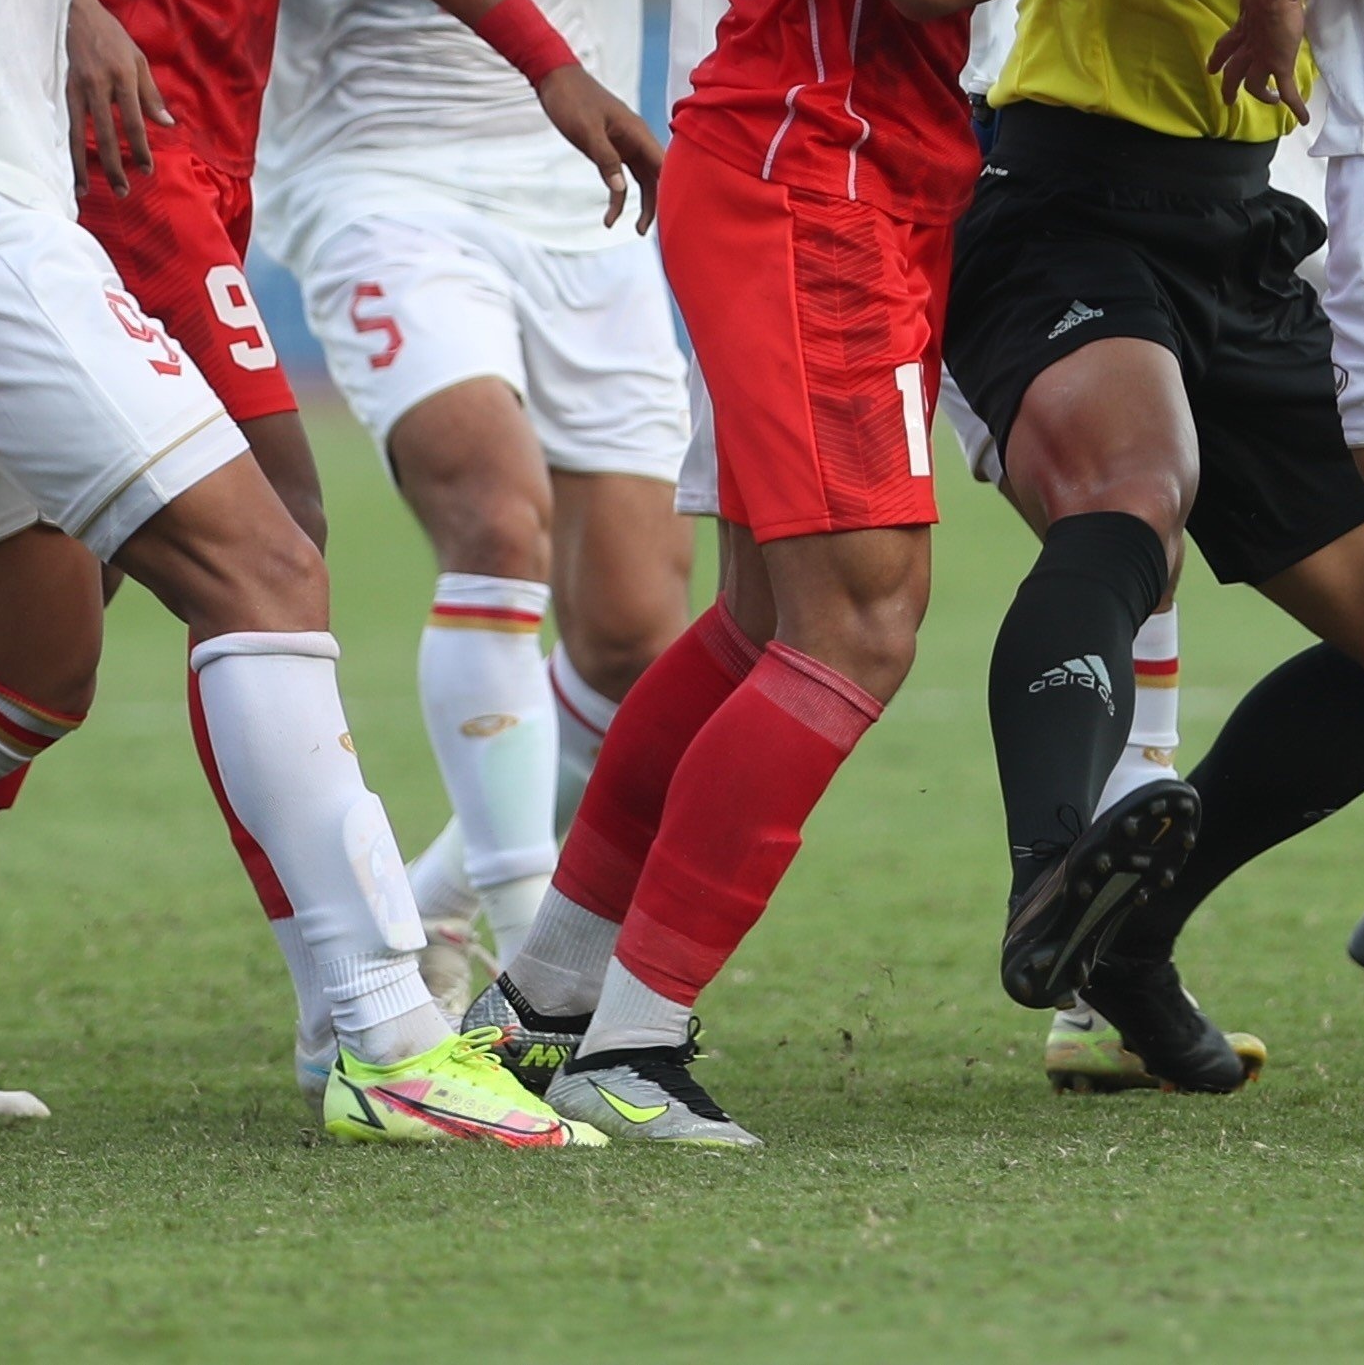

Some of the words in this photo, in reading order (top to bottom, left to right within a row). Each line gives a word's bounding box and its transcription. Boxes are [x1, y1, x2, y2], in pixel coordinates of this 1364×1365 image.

[205, 264, 277, 371] 9
[349, 281, 405, 370] 5
[1047, 306, 1105, 340] adidas
[894, 362, 931, 477] 1
[1028, 670, 1116, 717] adidas
